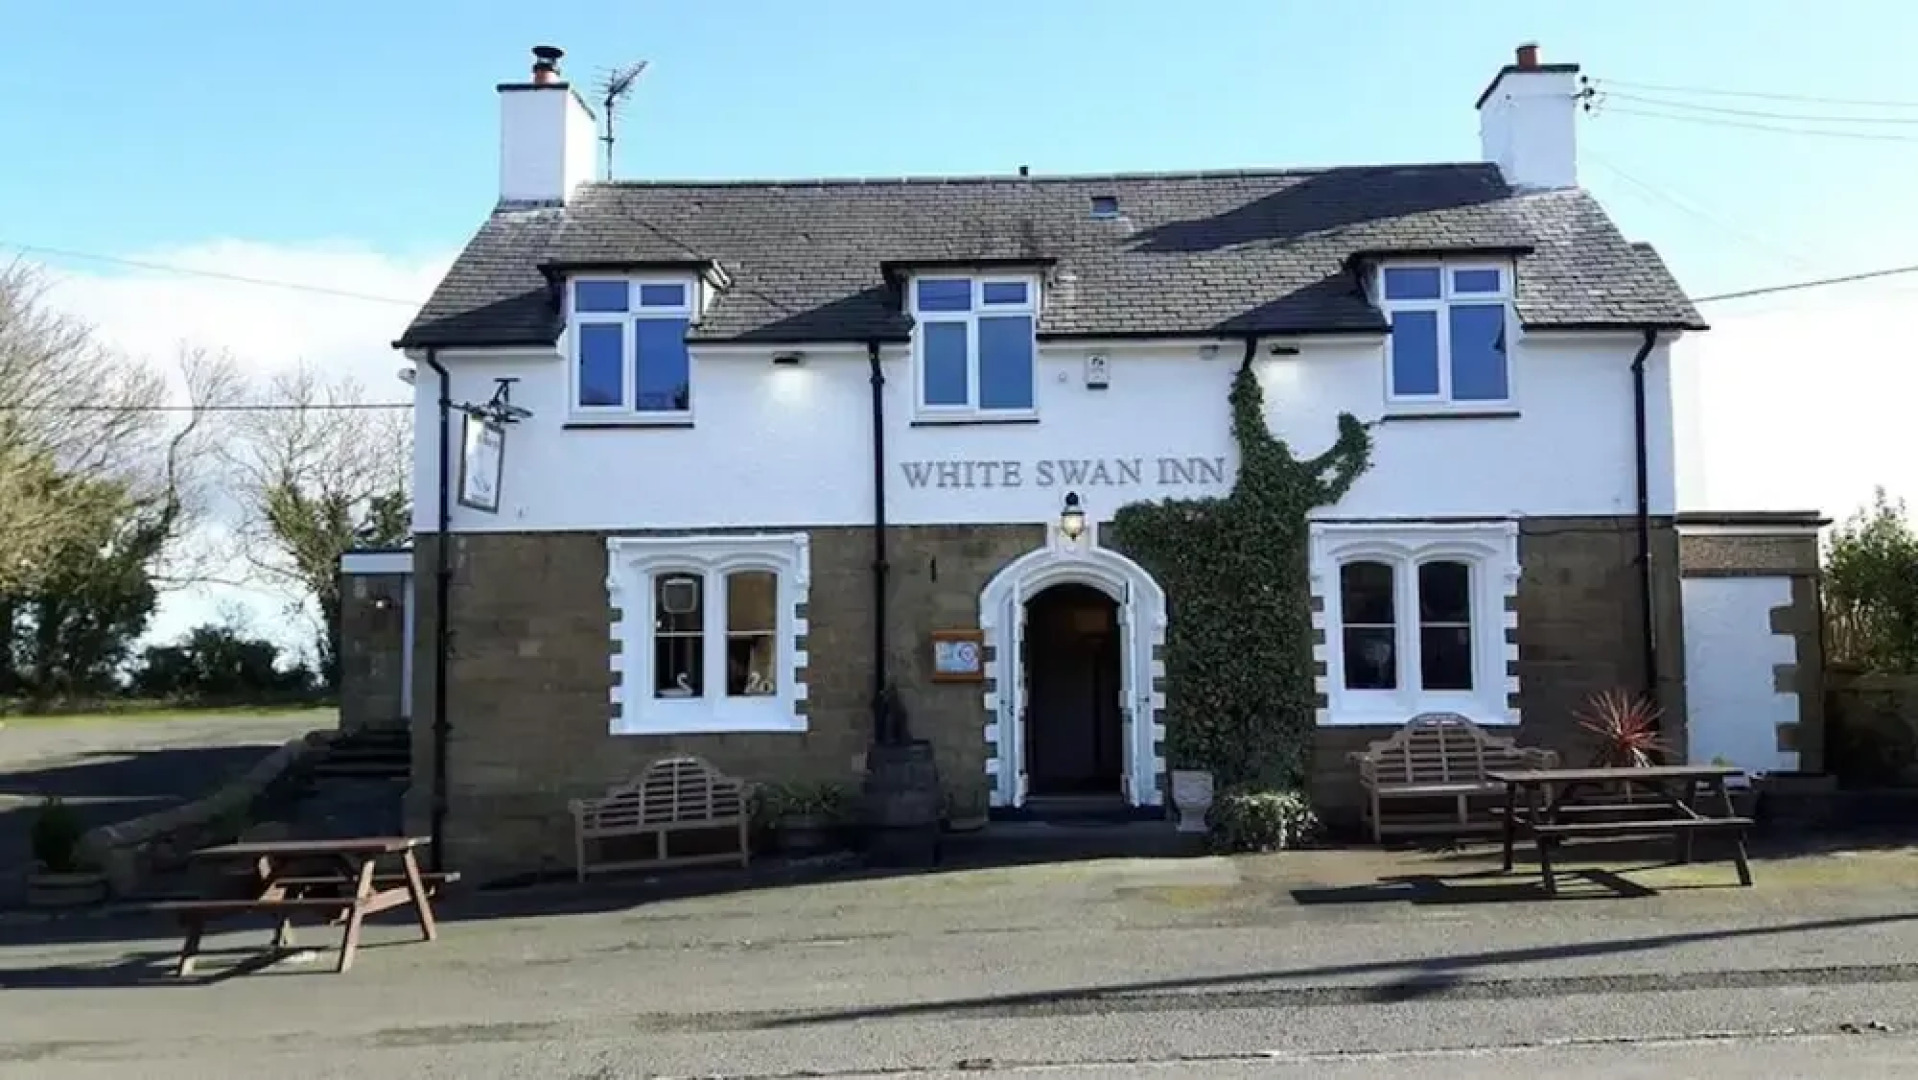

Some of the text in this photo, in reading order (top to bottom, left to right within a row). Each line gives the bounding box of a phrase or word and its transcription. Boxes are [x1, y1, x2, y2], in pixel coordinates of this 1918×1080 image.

[901, 457, 1224, 488] WHITE SWAN INN
